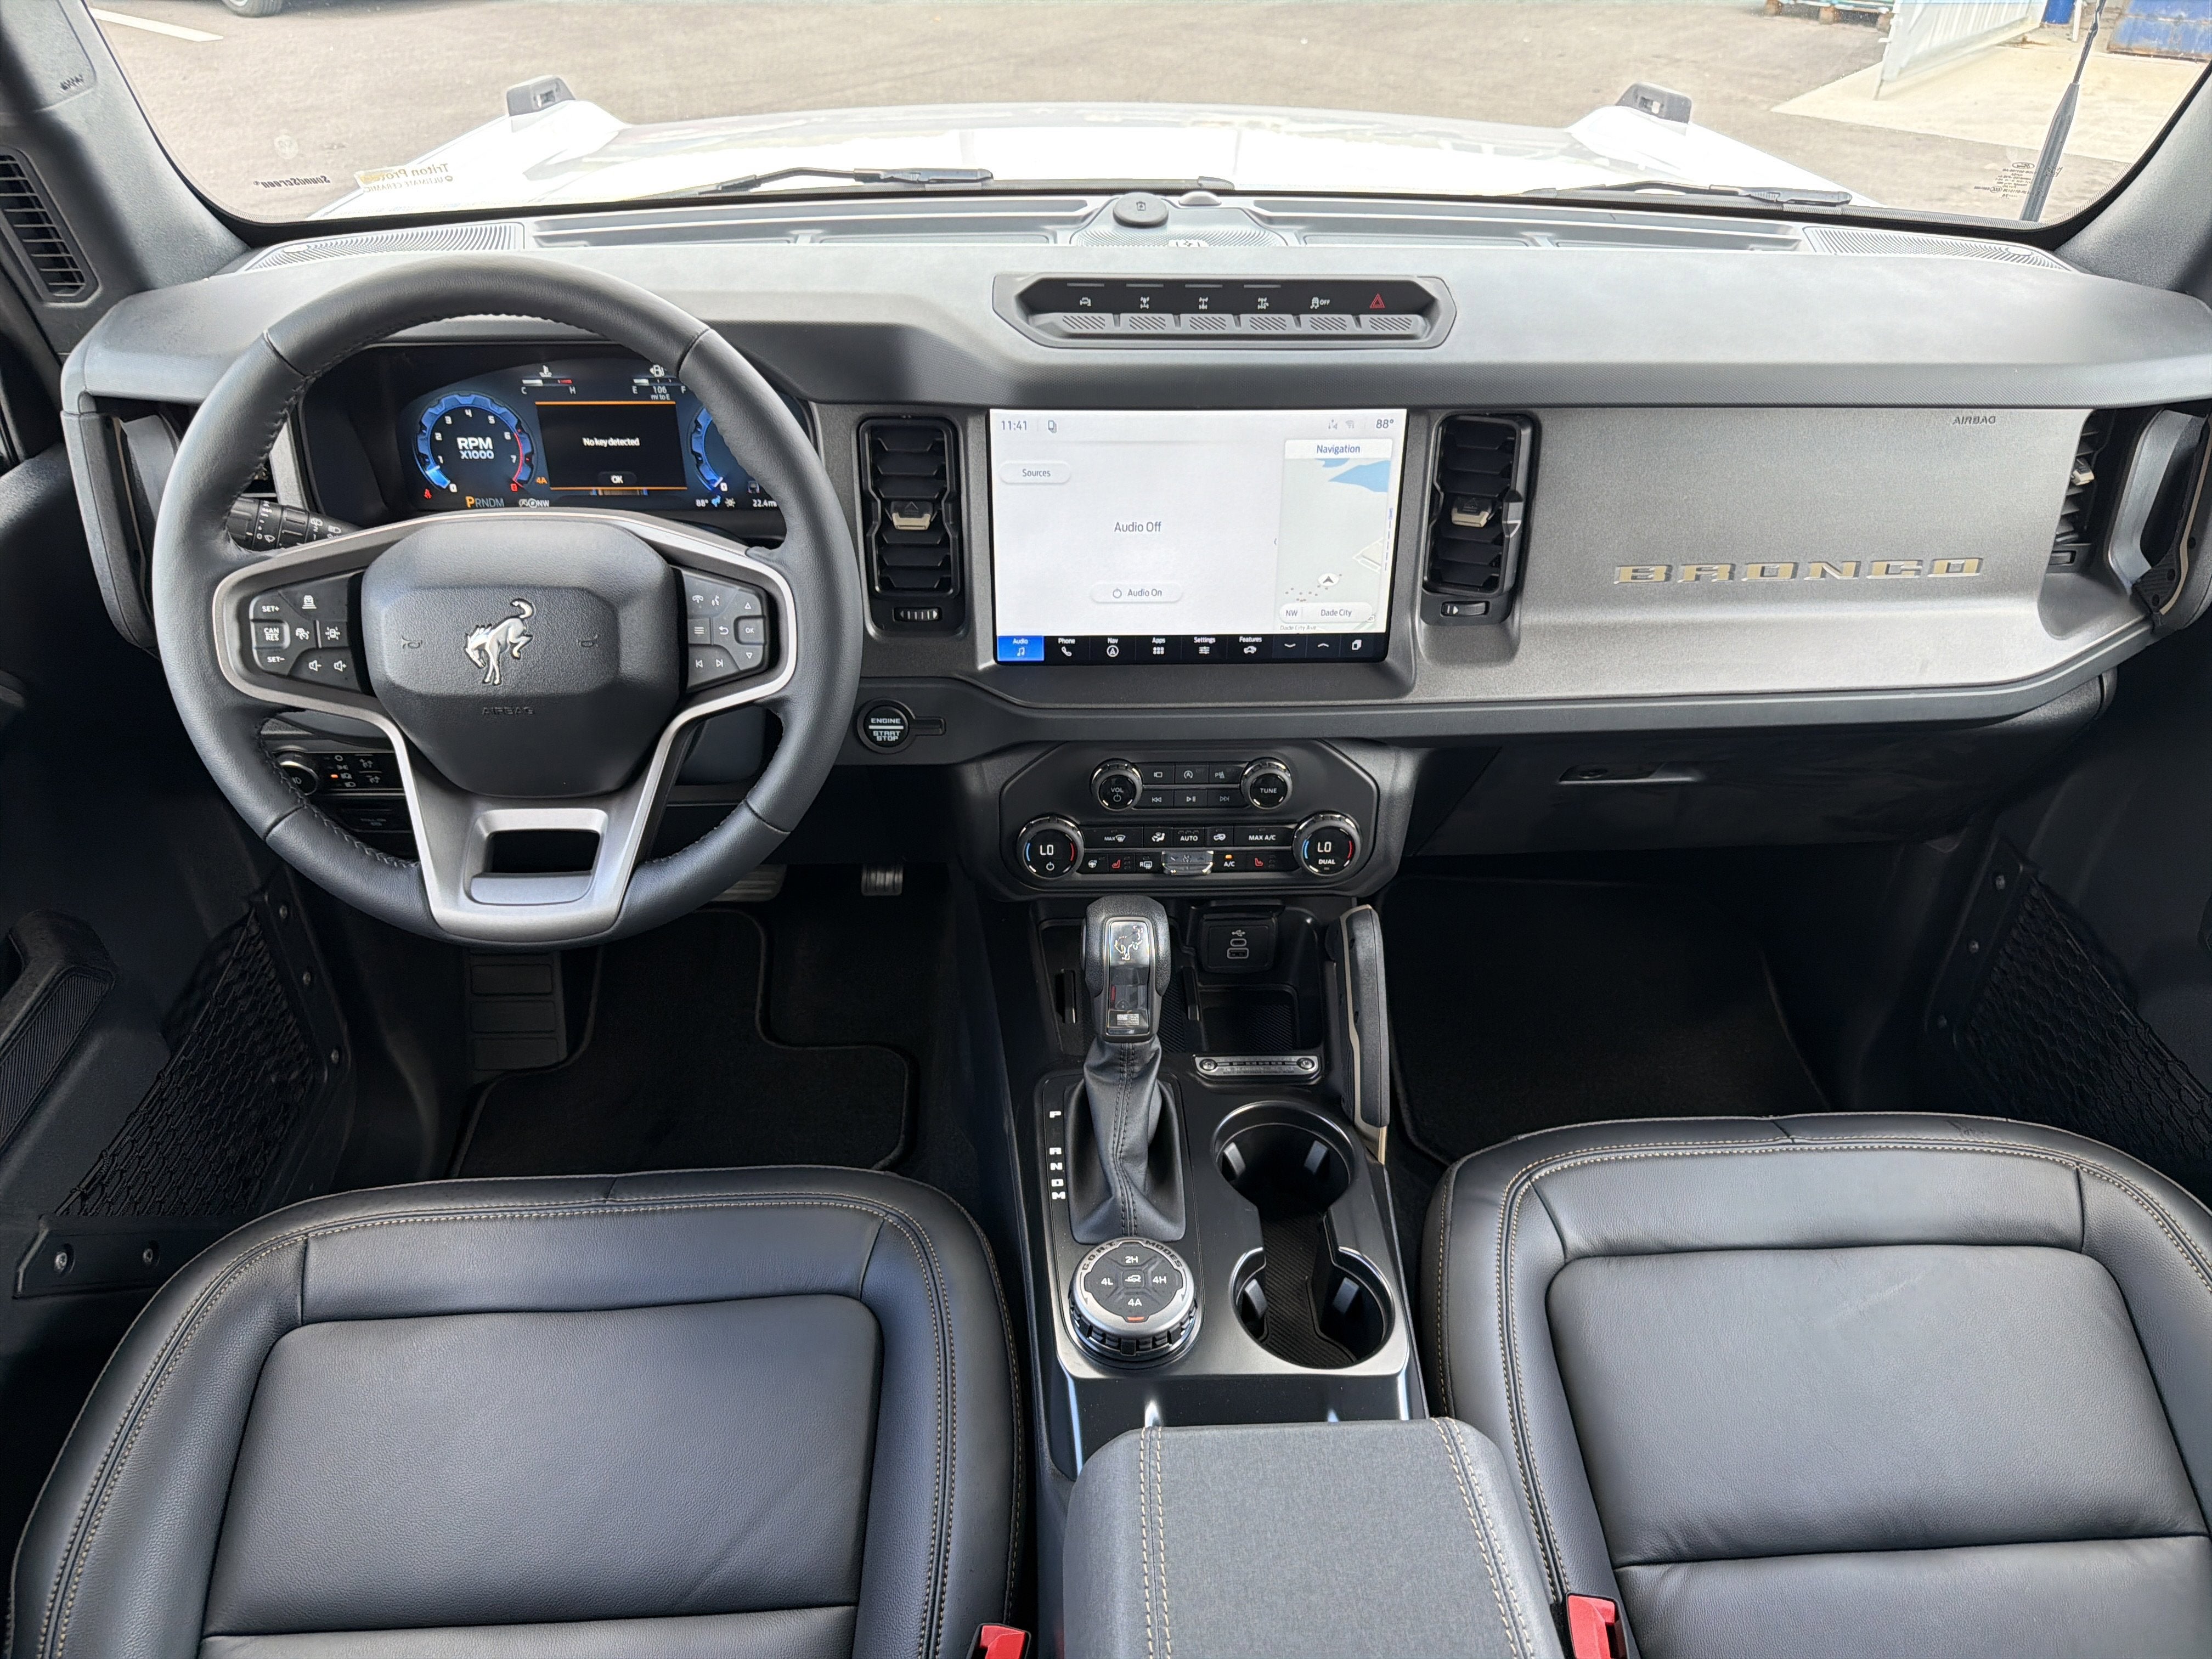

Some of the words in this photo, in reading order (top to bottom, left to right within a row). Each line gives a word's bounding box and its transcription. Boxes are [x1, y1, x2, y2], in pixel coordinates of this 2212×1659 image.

[521, 386, 527, 395] C
[569, 386, 576, 394] H
[632, 385, 638, 394] E
[652, 385, 667, 394] 106
[681, 385, 686, 394] F
[465, 409, 472, 417] 4
[445, 416, 453, 425] 3
[488, 415, 495, 424] 5
[1001, 420, 1028, 431] 11:41
[435, 432, 443, 441] 2
[504, 432, 511, 440] 6
[456, 437, 493, 450] RPM
[582, 437, 595, 447] No
[594, 437, 607, 448] key
[608, 437, 640, 447] detected
[1317, 444, 1361, 455] Navigation
[438, 455, 444, 464] 1
[459, 450, 494, 460] X1000
[511, 455, 517, 464] 7
[1022, 469, 1051, 478] Sources
[536, 477, 548, 485] 4A
[611, 475, 624, 484] OK
[449, 483, 458, 493] 0
[511, 483, 518, 492] 8
[720, 482, 728, 492] 0
[1114, 522, 1144, 533] Audio
[1146, 521, 1162, 533] Off
[1613, 557, 1984, 584] BRONCO
[1127, 589, 1149, 597] Audio
[1151, 589, 1163, 597] On
[1339, 608, 1352, 617] City
[1040, 844, 1054, 856] LO
[1317, 841, 1332, 853] LO
[1050, 1162, 1063, 1171] N
[1052, 1191, 1066, 1200] M
[1145, 1240, 1183, 1268] MODES
[1153, 1276, 1167, 1284] 4H
[1127, 1298, 1142, 1307] 4A
